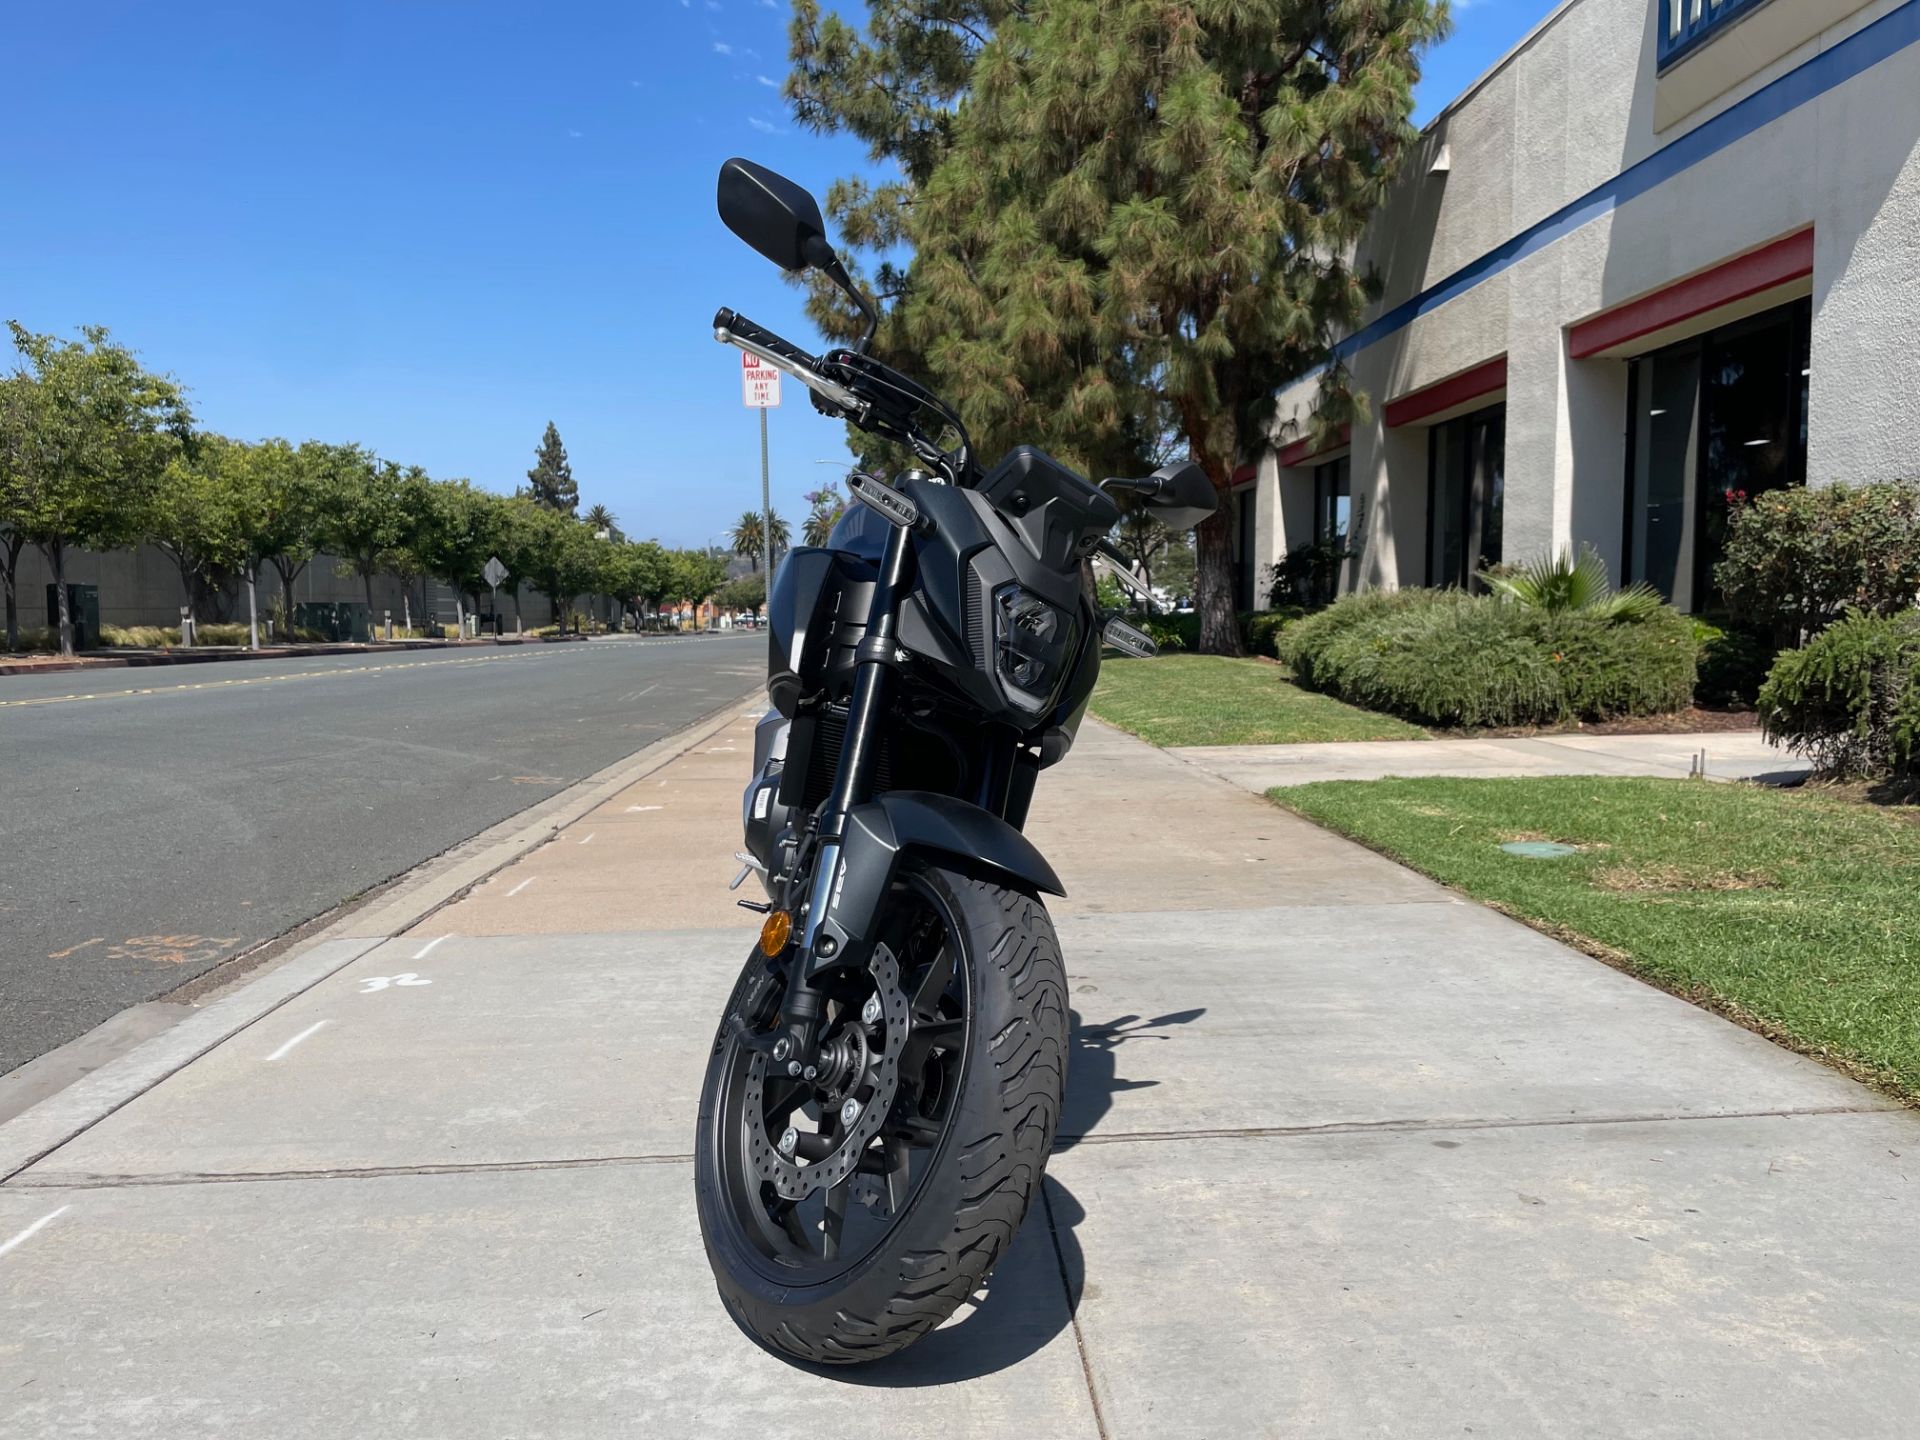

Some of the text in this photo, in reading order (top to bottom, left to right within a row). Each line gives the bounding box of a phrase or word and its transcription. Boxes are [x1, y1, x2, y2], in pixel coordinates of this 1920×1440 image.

[744, 352, 759, 367] NO
[746, 370, 777, 380] PARKING
[755, 382, 768, 390] ANY
[754, 392, 769, 400] TIME
[832, 857, 847, 910] ABS
